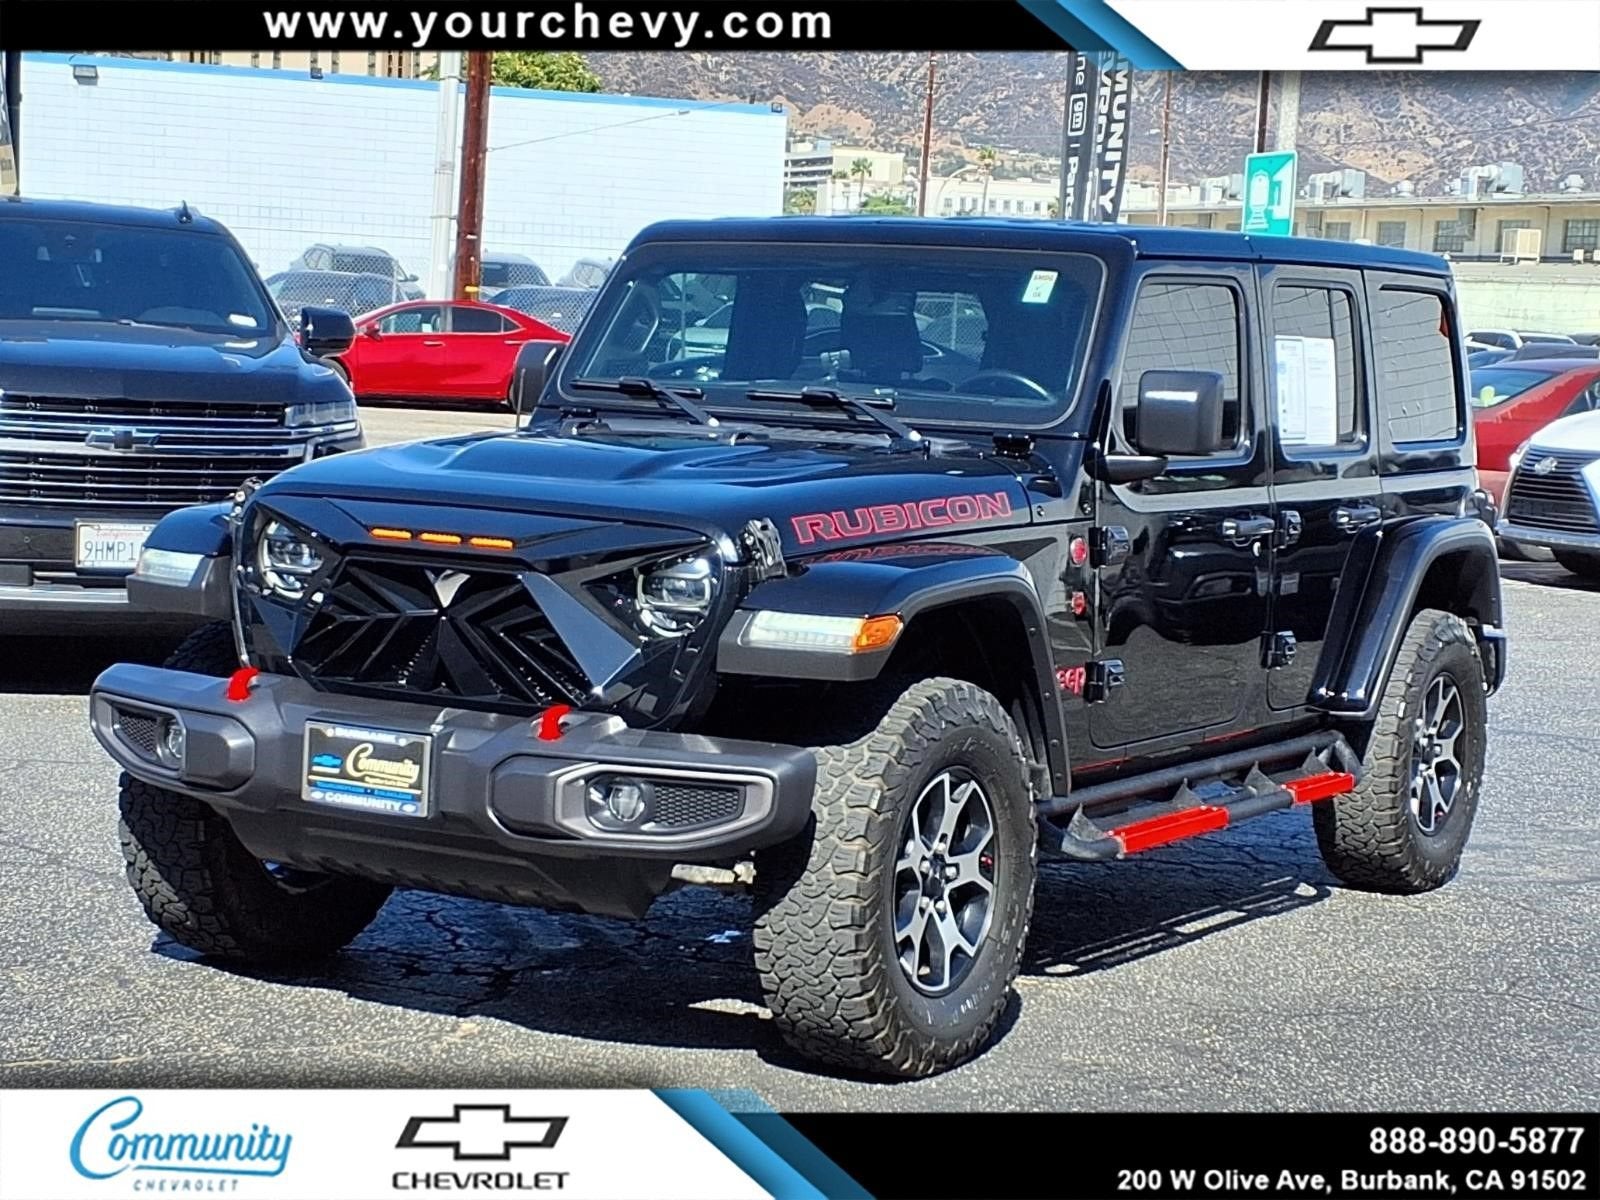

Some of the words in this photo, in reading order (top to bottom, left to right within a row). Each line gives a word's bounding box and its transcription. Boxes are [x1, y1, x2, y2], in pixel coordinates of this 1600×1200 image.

[1098, 54, 1129, 215] MUNITY
[790, 491, 1013, 545] RUBICON
[84, 541, 143, 561] 9HMP1
[346, 743, 420, 784] Community
[325, 792, 402, 811] COMMUNITY
